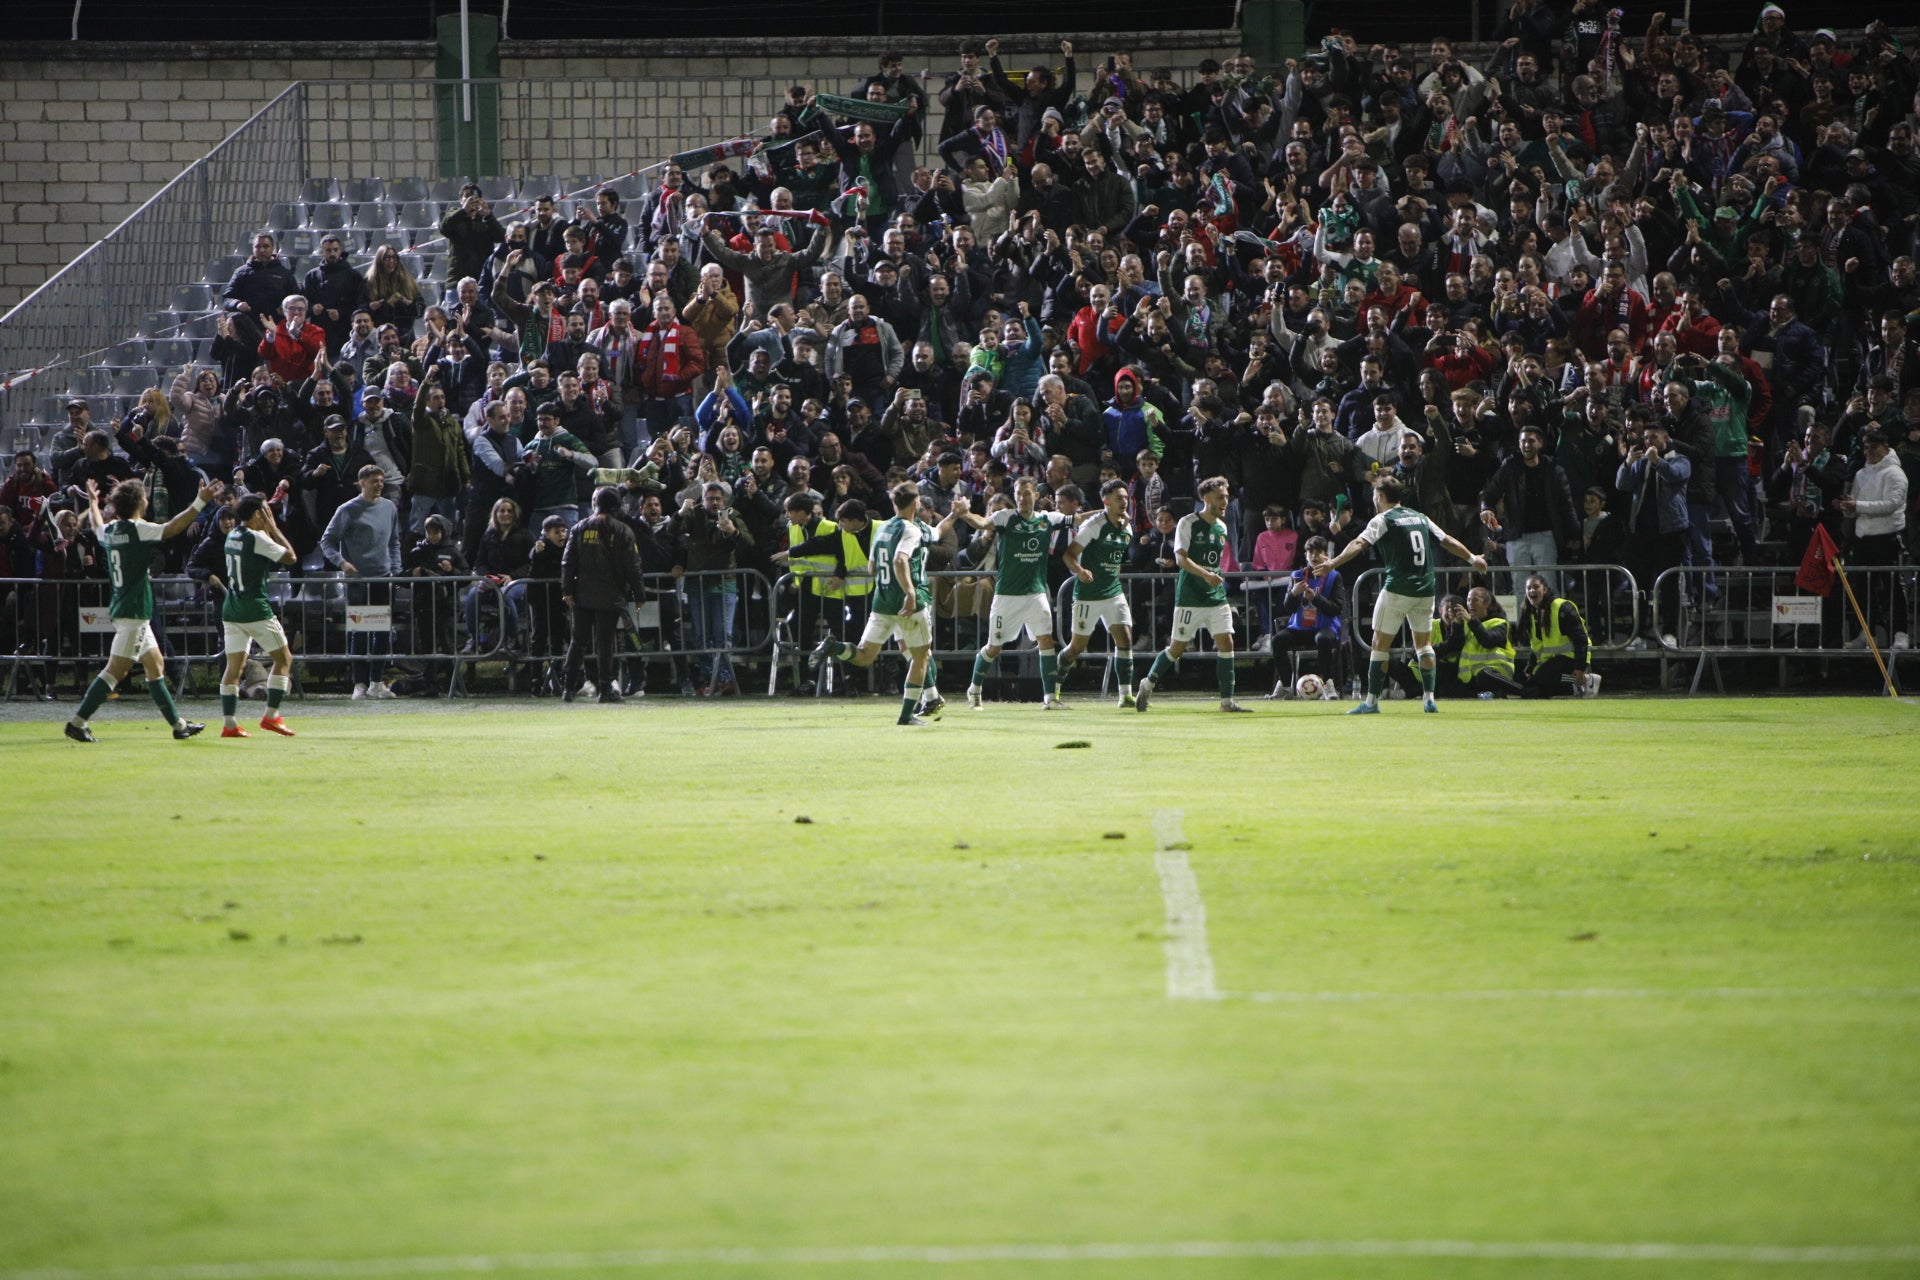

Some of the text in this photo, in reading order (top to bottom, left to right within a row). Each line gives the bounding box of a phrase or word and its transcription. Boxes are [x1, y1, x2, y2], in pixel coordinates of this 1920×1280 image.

[1410, 530, 1425, 566] 9
[110, 549, 123, 588] 3
[879, 547, 890, 585] 5
[996, 615, 1003, 629] 6
[1079, 603, 1090, 619] 11
[1179, 608, 1192, 625] 10
